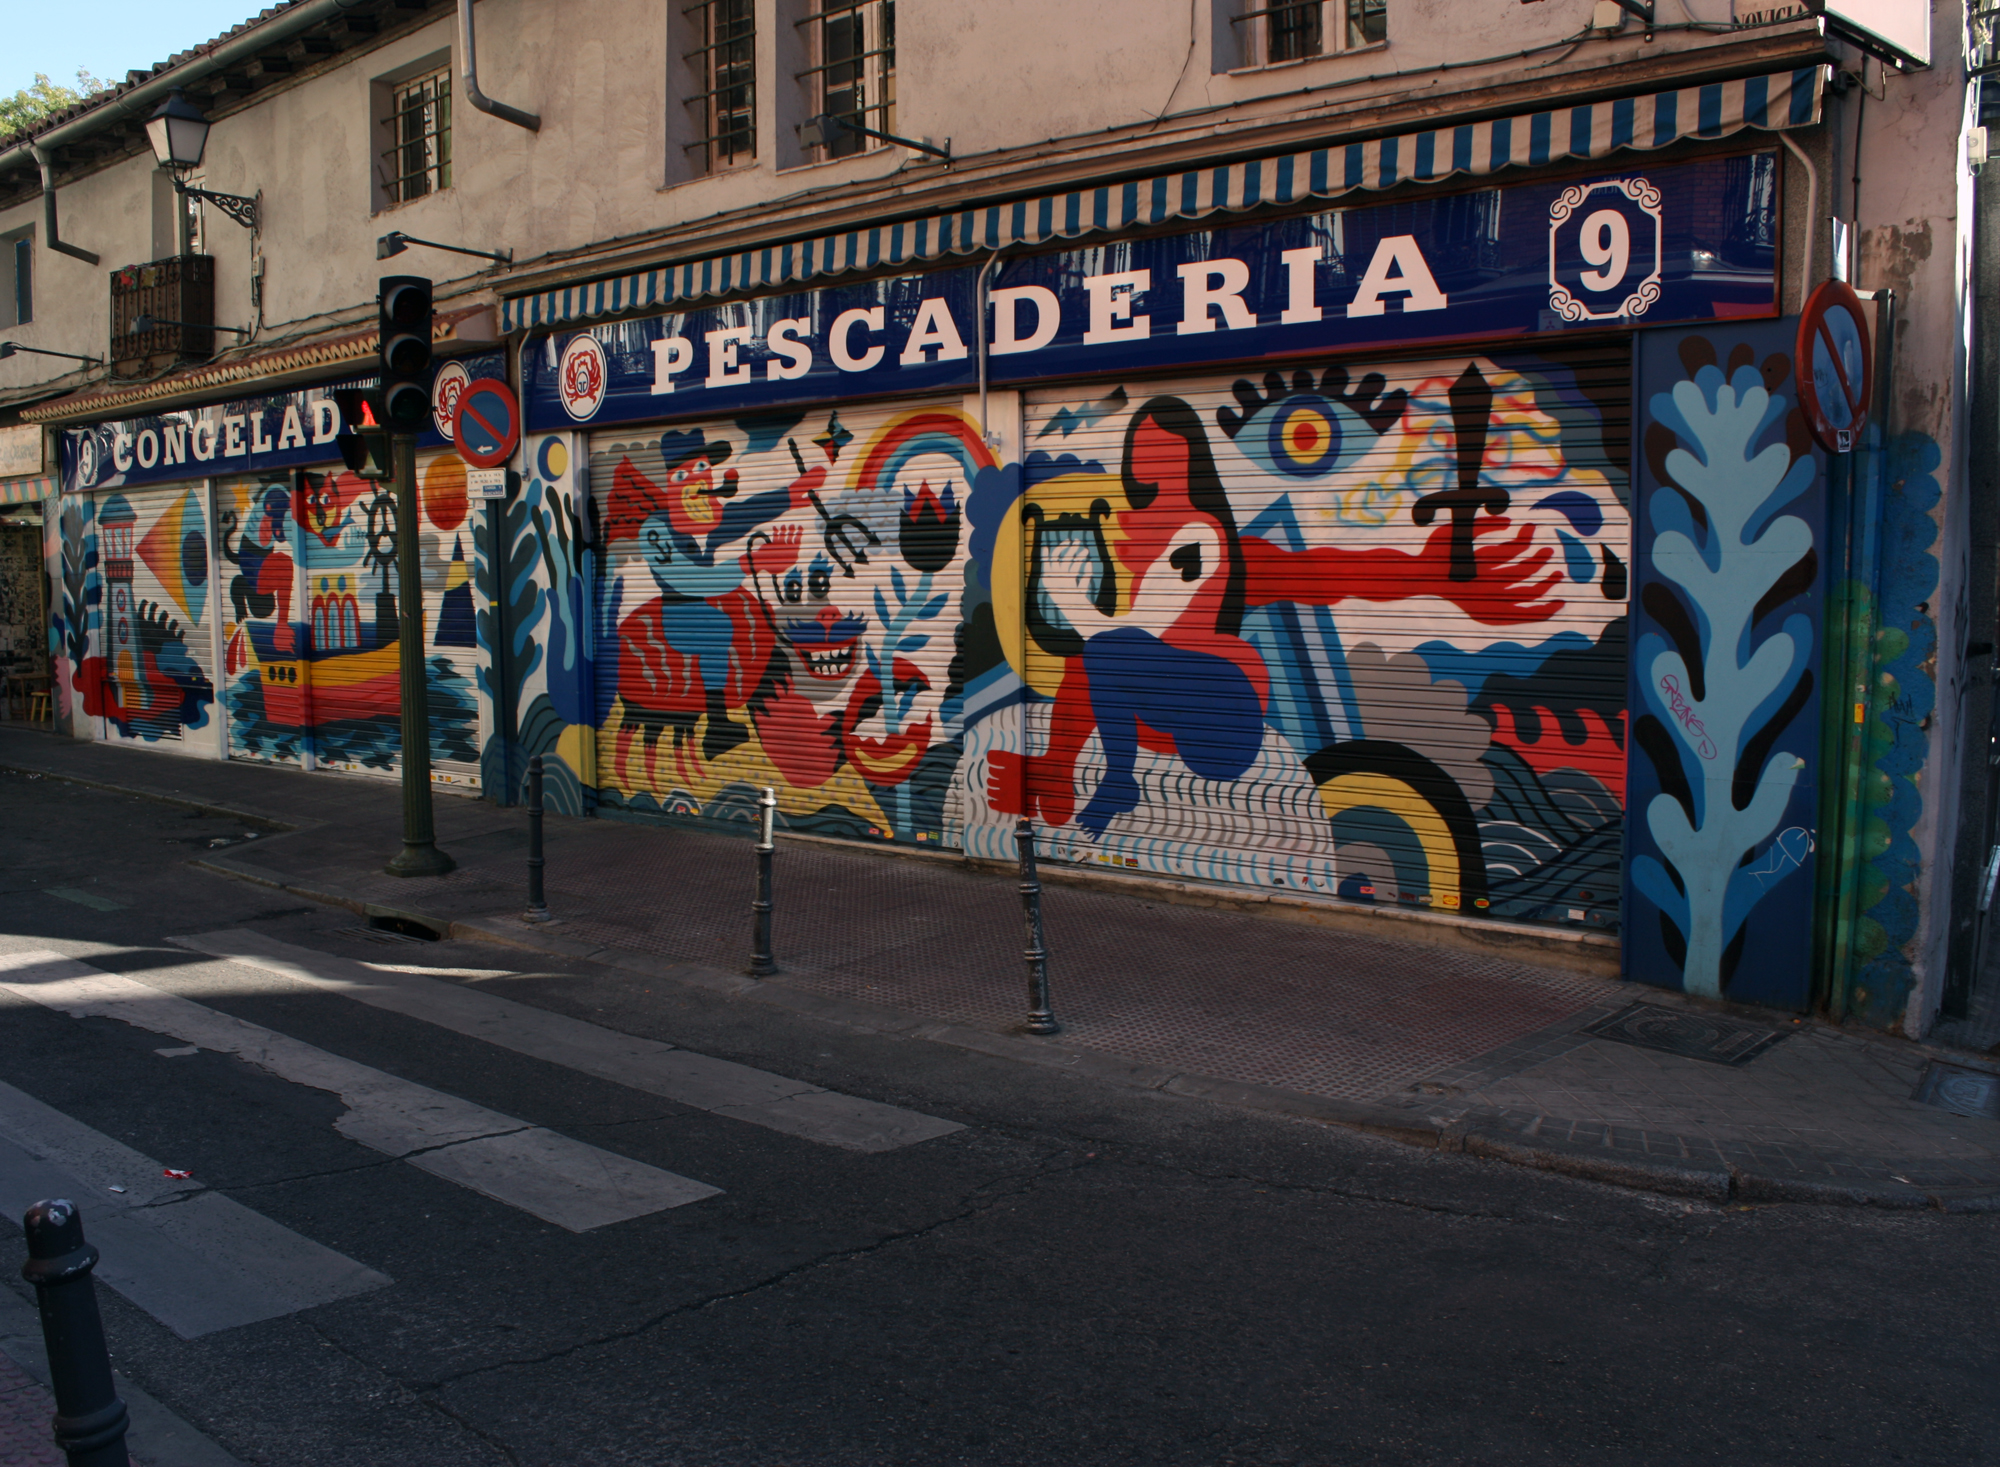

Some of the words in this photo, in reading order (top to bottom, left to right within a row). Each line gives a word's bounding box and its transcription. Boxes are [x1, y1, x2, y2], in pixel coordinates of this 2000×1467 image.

[650, 234, 1448, 396] PESCADERIA
[1579, 208, 1630, 292] 9
[112, 400, 357, 472] CONGELAD
